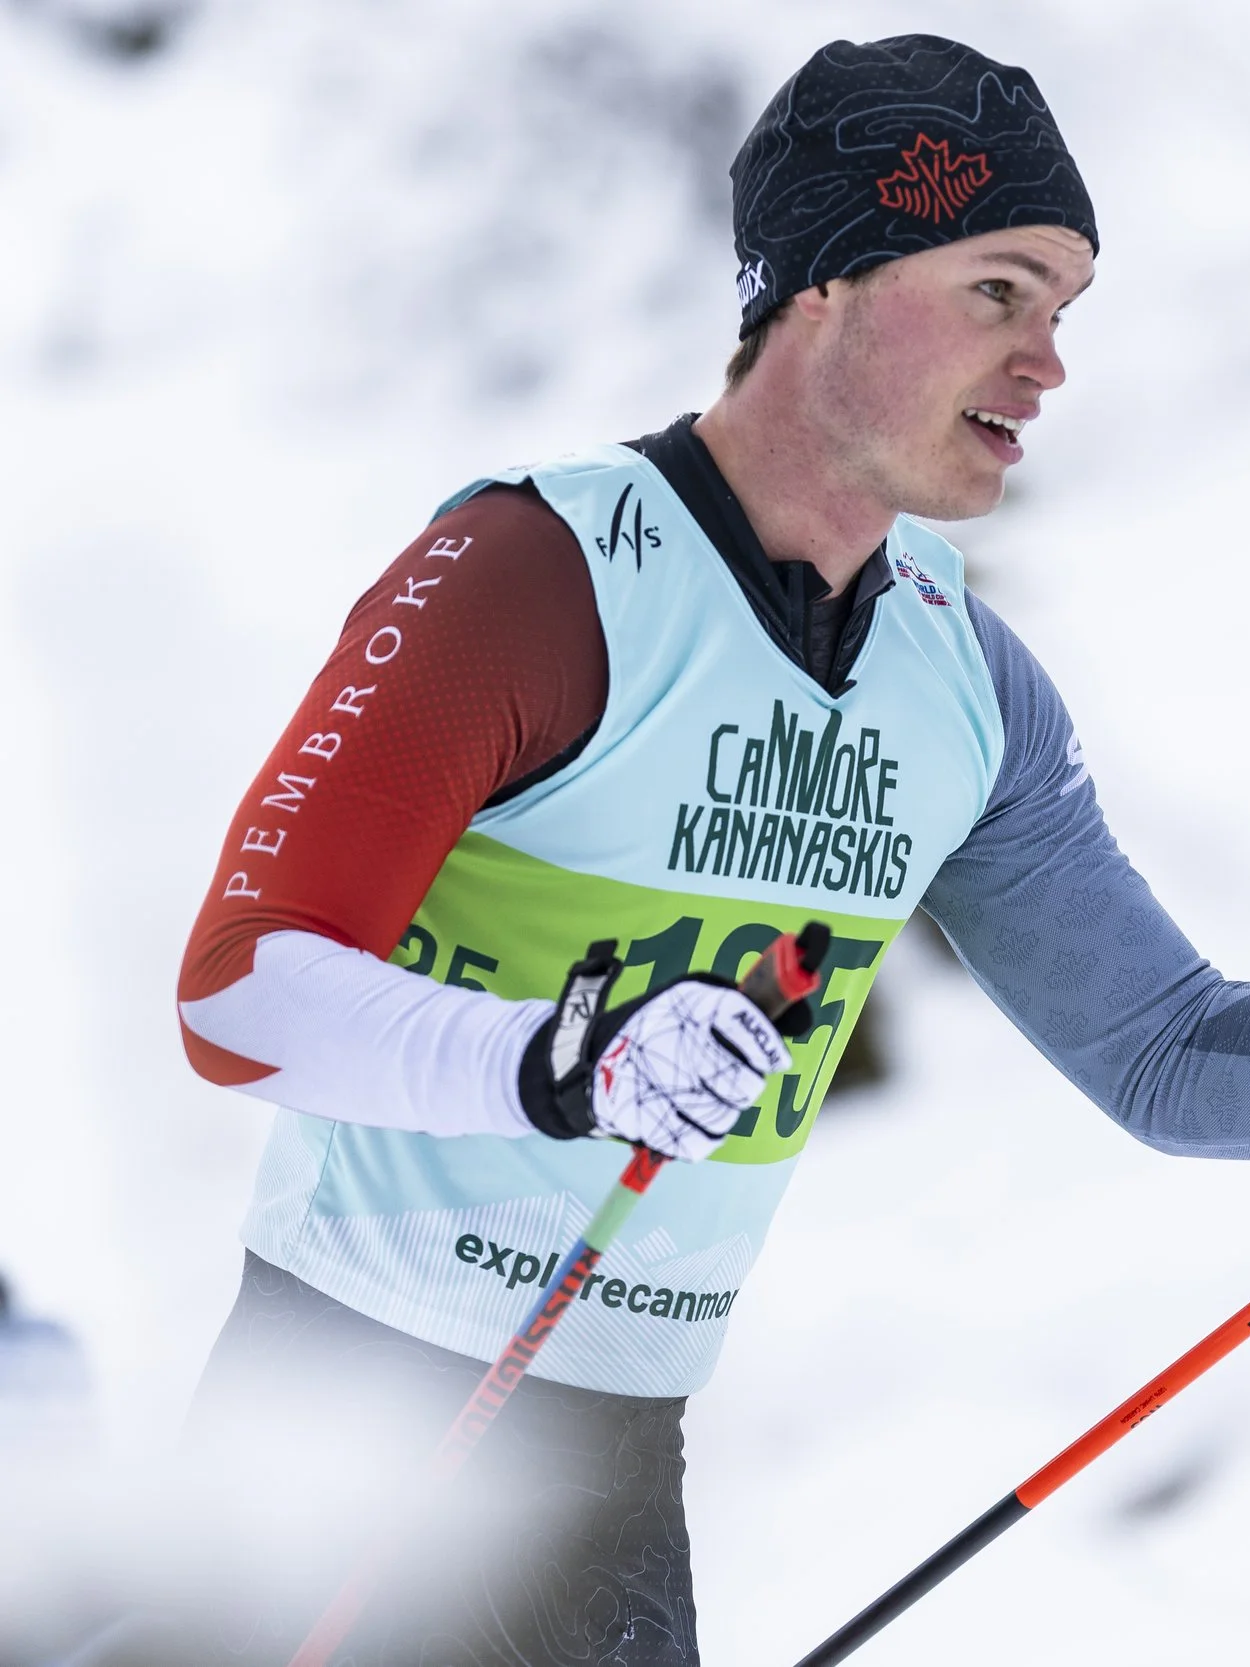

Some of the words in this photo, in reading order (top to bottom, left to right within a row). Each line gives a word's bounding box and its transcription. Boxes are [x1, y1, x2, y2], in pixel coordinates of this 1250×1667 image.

[222, 535, 473, 901] PEMBROKE
[706, 698, 899, 827] CANMORE
[667, 803, 913, 899] KANANASKIS
